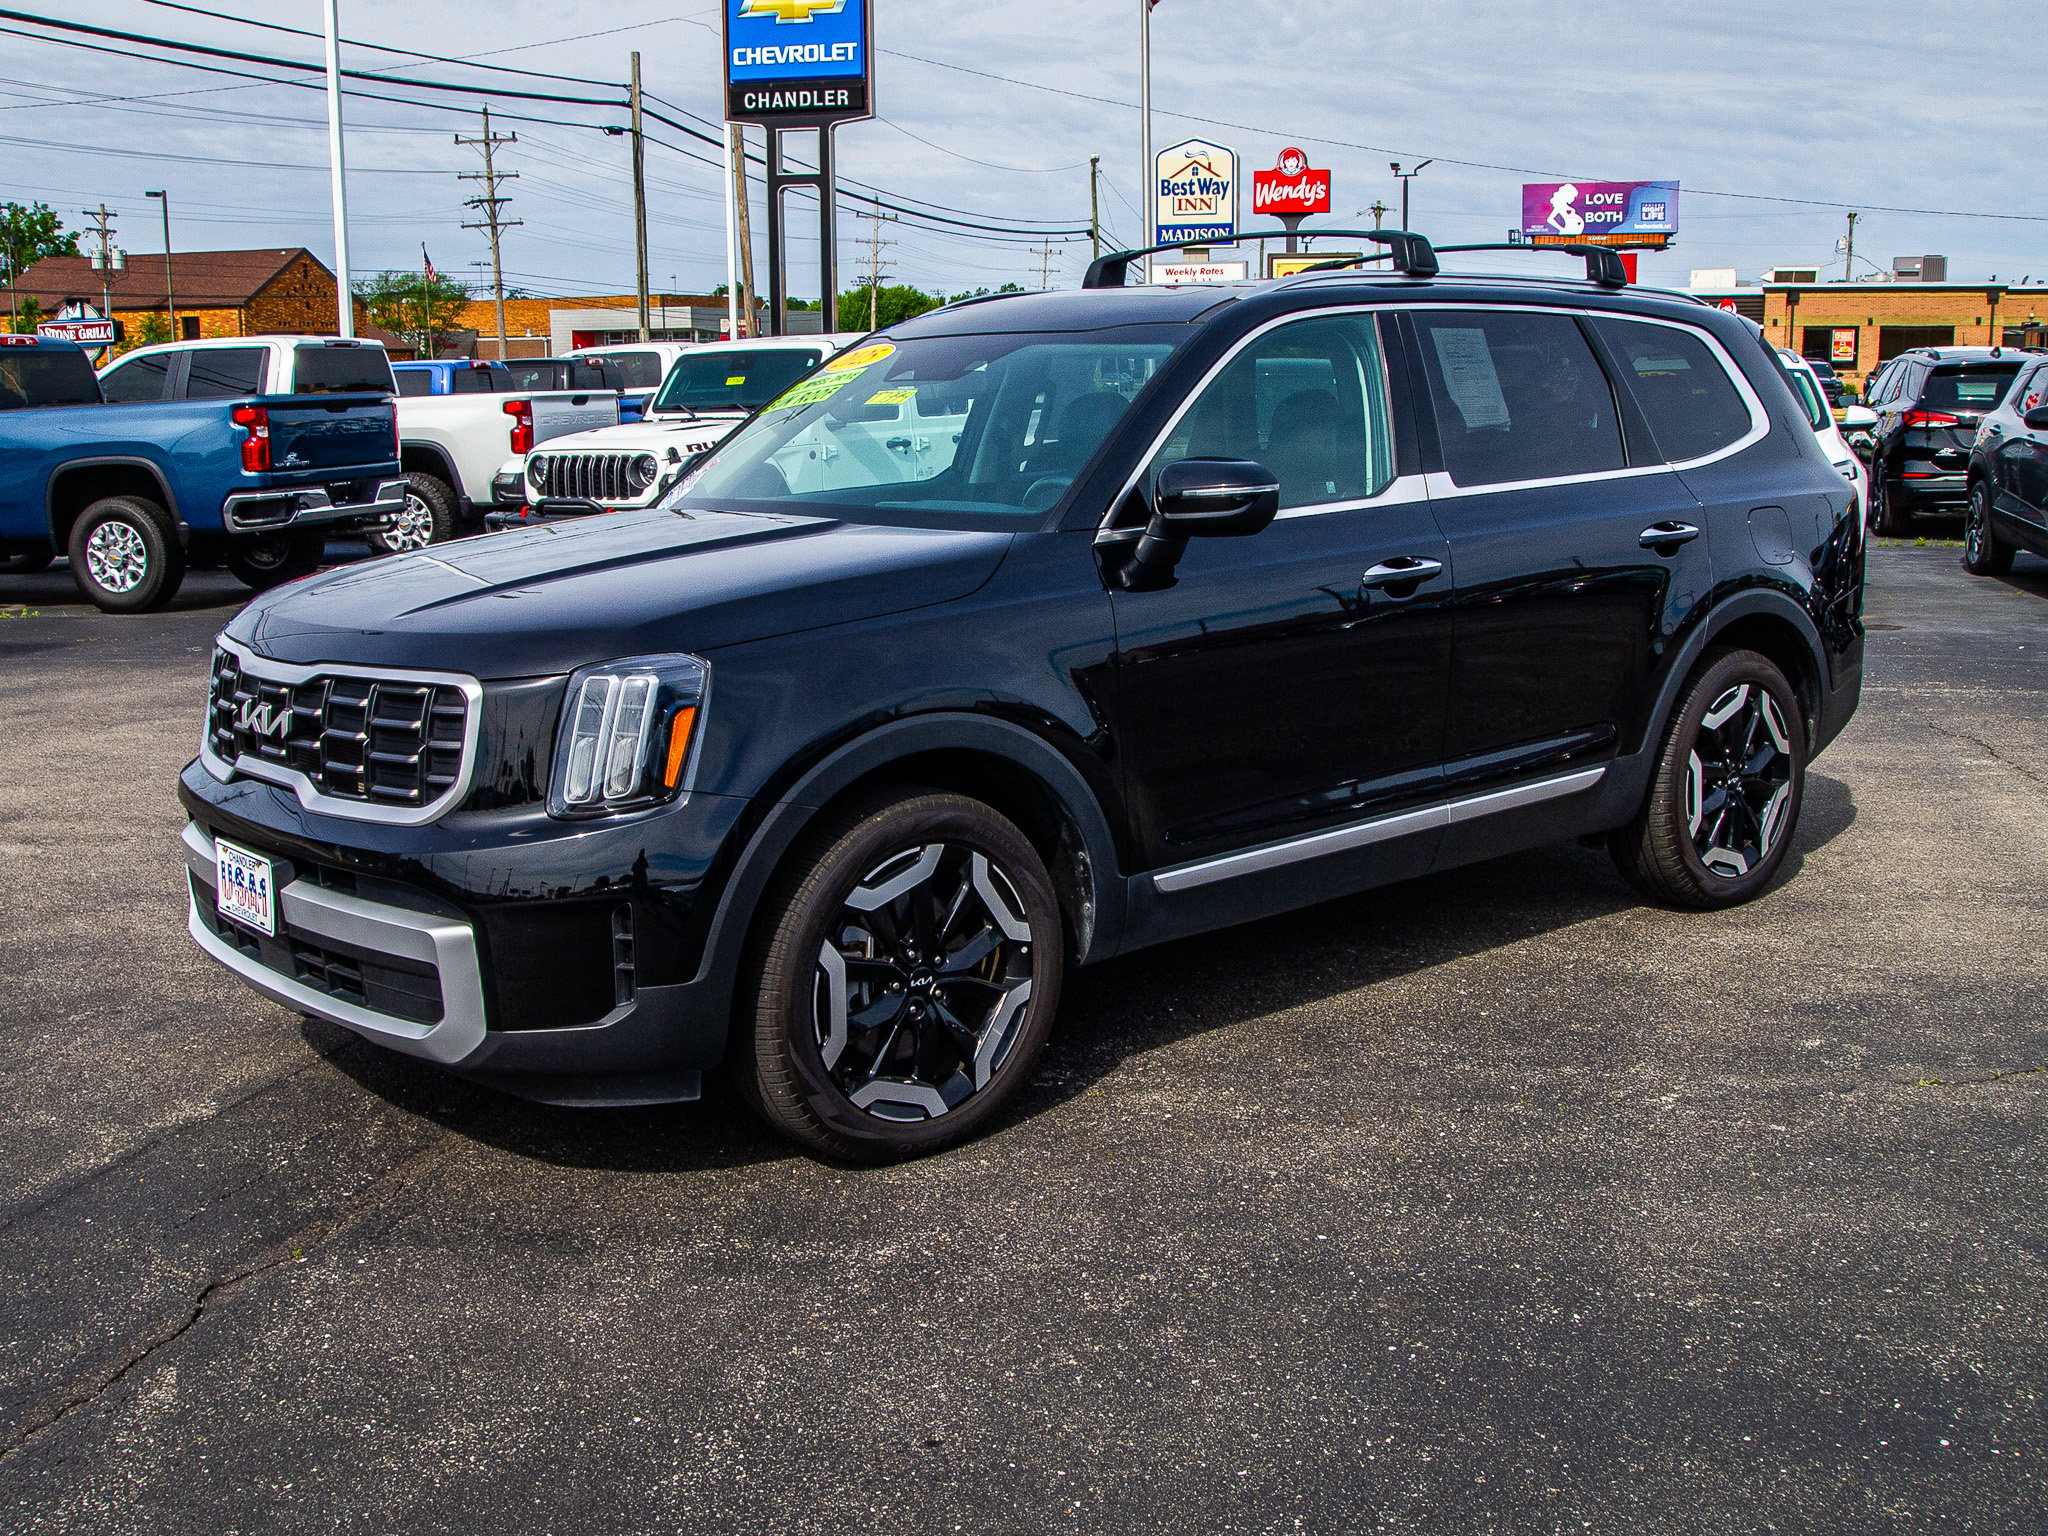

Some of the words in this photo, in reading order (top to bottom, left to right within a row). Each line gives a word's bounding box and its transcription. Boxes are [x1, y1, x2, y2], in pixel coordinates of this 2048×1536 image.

[733, 42, 858, 66] CHEVROLET
[744, 89, 849, 109] CHANDLER
[1161, 178, 1195, 196] Best
[1197, 177, 1230, 200] Way
[1255, 175, 1327, 207] Wendy's
[1177, 197, 1212, 211] INN
[1585, 193, 1624, 205] LOVE
[1584, 211, 1623, 223] BOTH
[1642, 212, 1665, 220] LIFE
[1160, 228, 1230, 242] MADISON
[1165, 268, 1197, 277] Weekly
[1200, 267, 1224, 275] Rates
[45, 327, 76, 341] STONE
[78, 326, 107, 339] GRILL
[229, 851, 257, 871] CHANDLER
[232, 903, 258, 922] CHEVROLET
